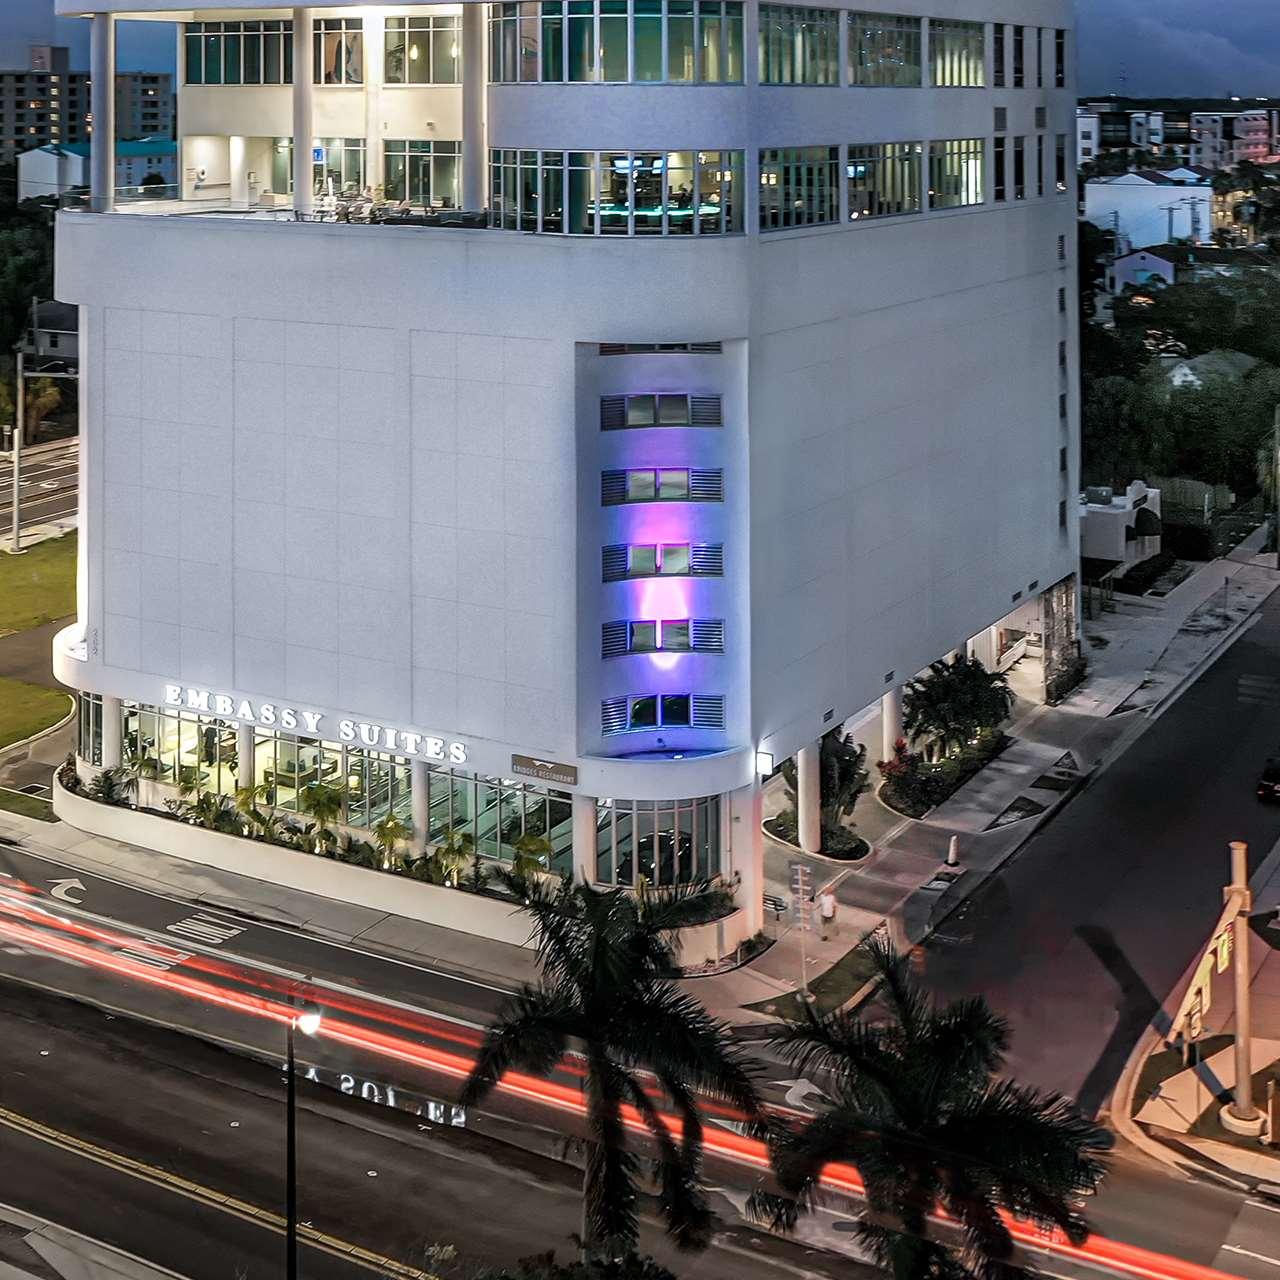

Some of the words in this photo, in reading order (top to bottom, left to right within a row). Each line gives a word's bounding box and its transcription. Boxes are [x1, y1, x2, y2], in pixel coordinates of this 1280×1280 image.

[164, 684, 325, 734] EMBASSY
[338, 720, 470, 764] SUITES
[538, 770, 576, 783] RESTAURANT
[166, 912, 249, 944] ONLY
